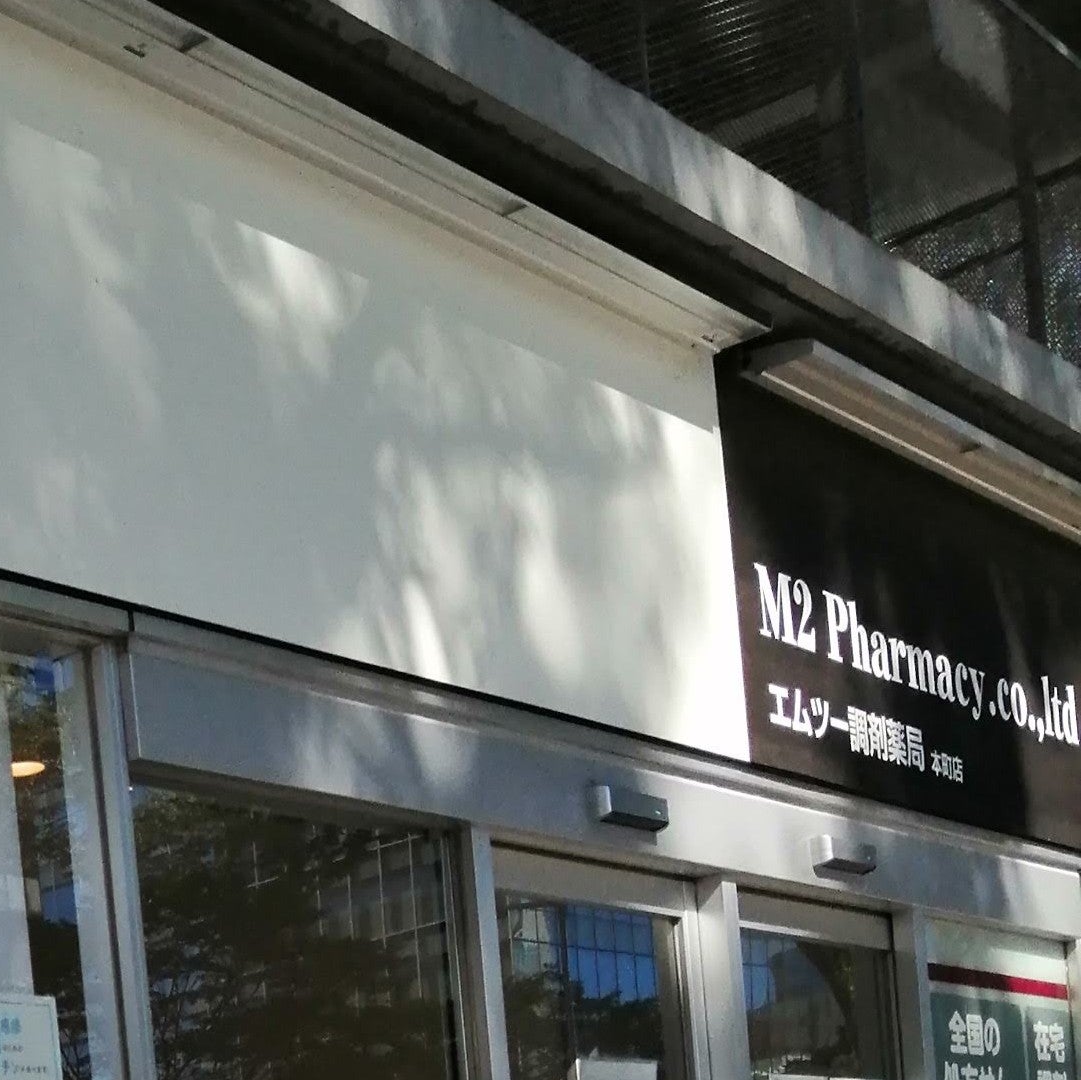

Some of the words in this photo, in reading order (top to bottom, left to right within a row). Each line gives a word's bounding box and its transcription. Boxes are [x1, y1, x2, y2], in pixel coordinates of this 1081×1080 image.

[753, 561, 816, 653] M2
[768, 682, 925, 773] エムツー調剤薬局
[930, 750, 964, 784] 本町店
[948, 1010, 1001, 1057] 全国の
[1032, 1020, 1066, 1064] 在宅
